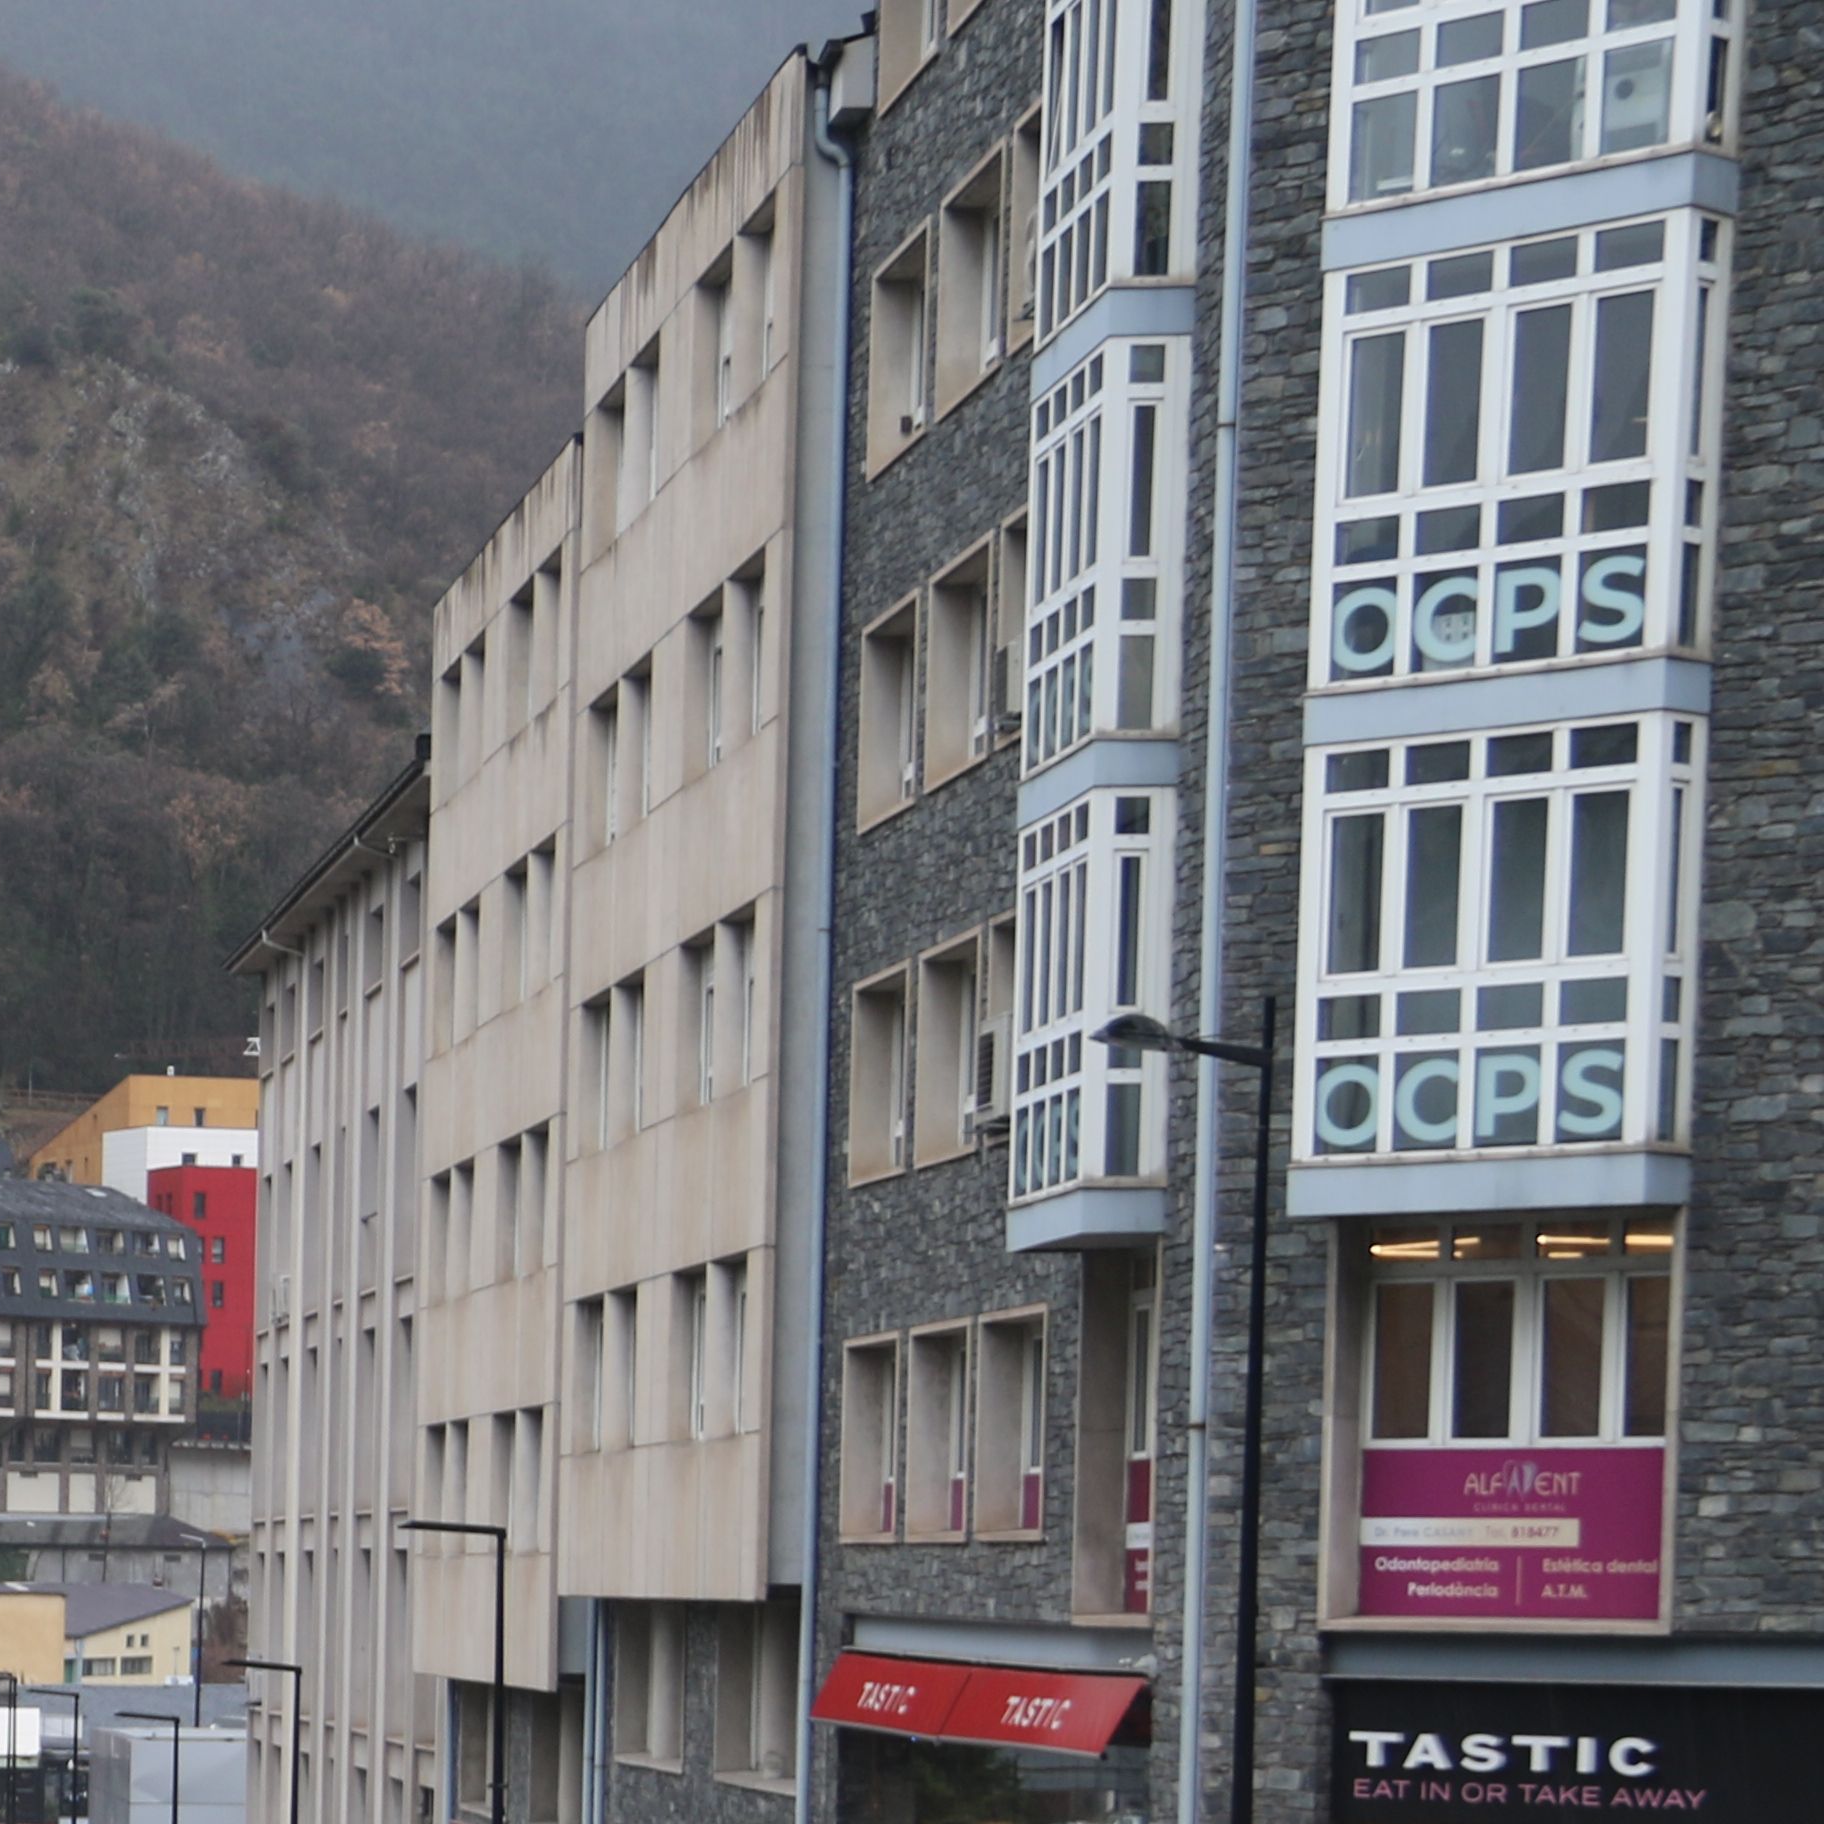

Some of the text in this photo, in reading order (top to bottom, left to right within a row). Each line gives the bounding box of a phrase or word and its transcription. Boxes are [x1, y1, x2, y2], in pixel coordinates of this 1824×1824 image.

[1332, 555, 1645, 672] OCPS
[1316, 1050, 1624, 1147] OCPS
[1606, 1556, 1658, 1574] dental
[857, 1681, 917, 1715] TASTIC
[1000, 1696, 1072, 1730] TASTIC
[1349, 1730, 1656, 1777] TASTIC
[1353, 1778, 1707, 1811] EAT IN OR TAKE AWAY
